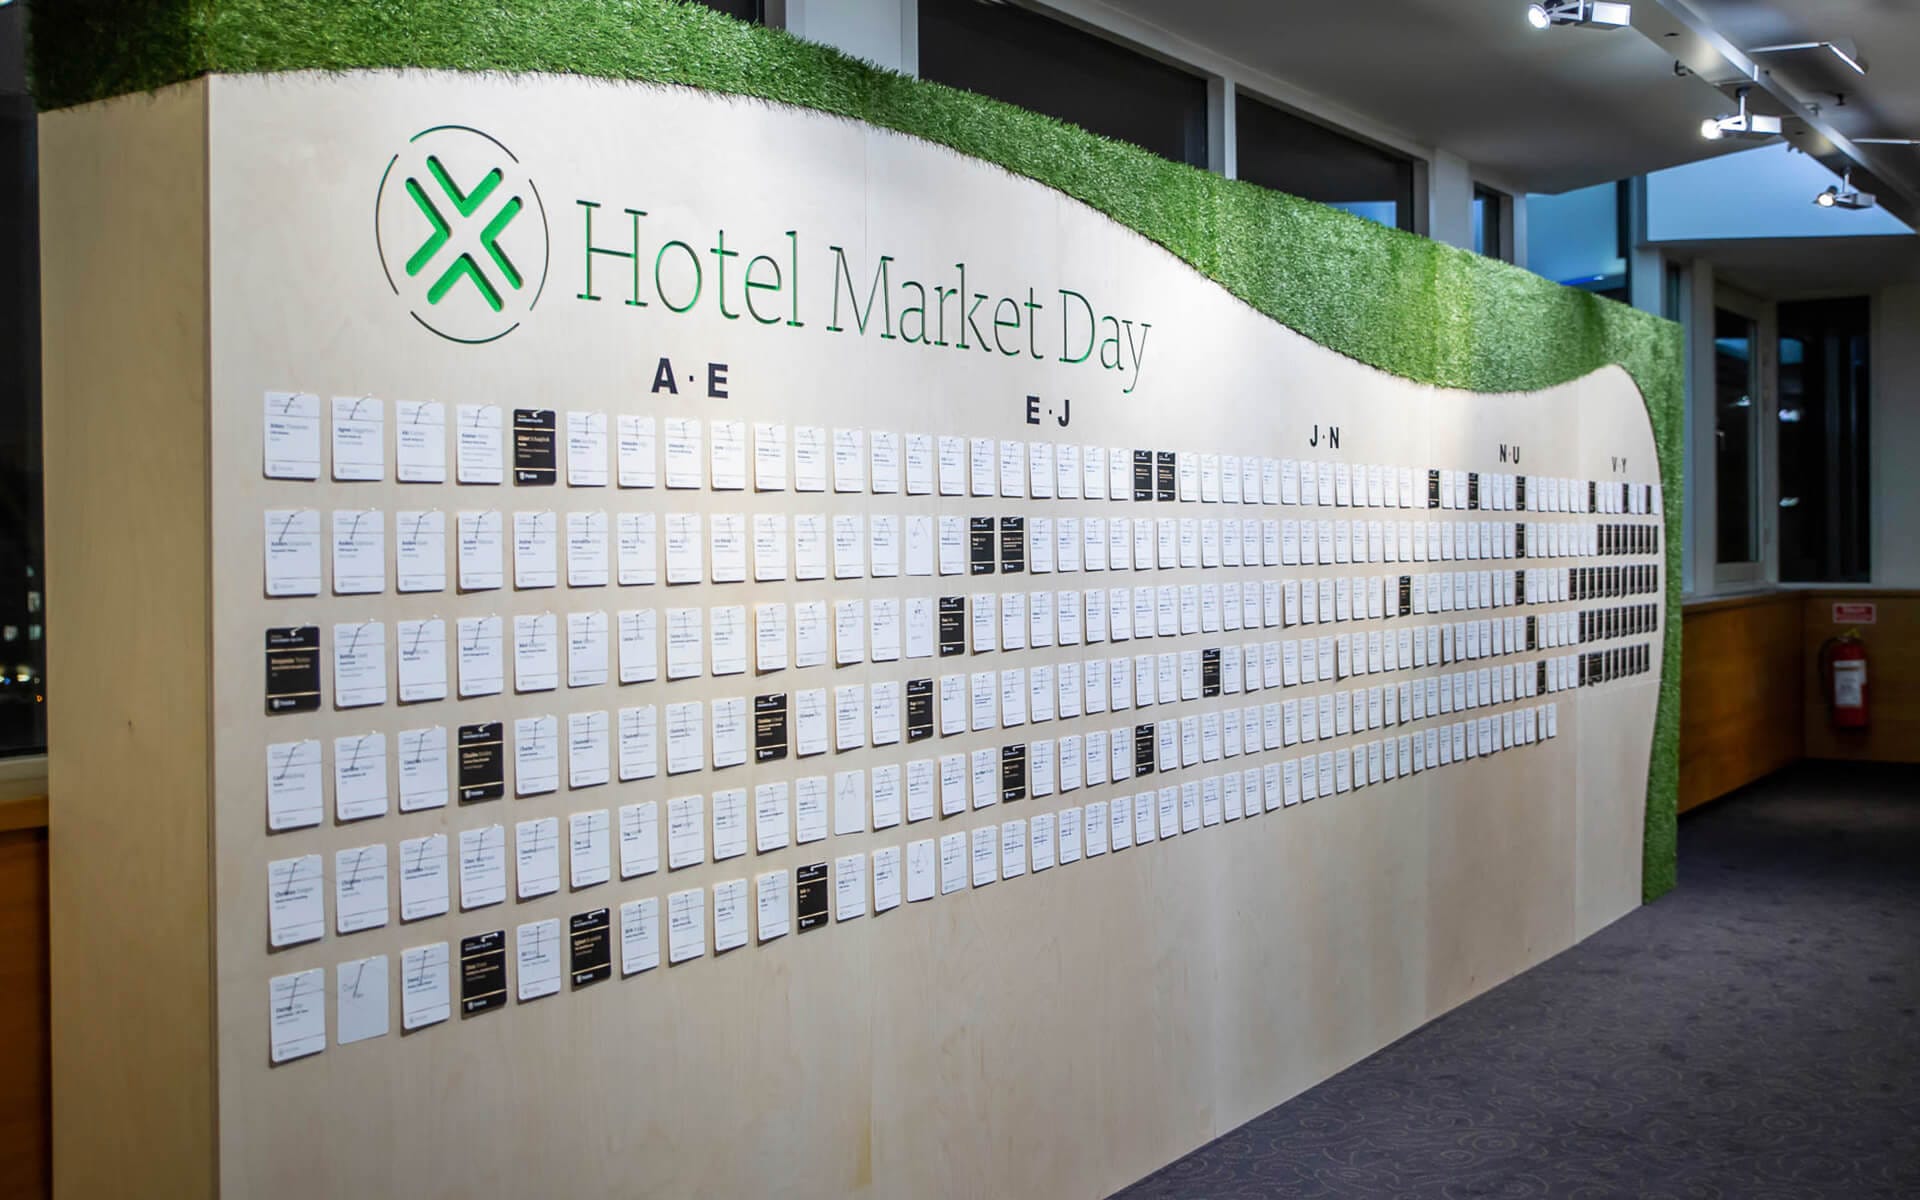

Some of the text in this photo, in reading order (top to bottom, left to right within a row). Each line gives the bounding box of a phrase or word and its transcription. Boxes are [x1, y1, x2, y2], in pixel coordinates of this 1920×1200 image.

[576, 199, 1153, 393] Hotel Market Day
